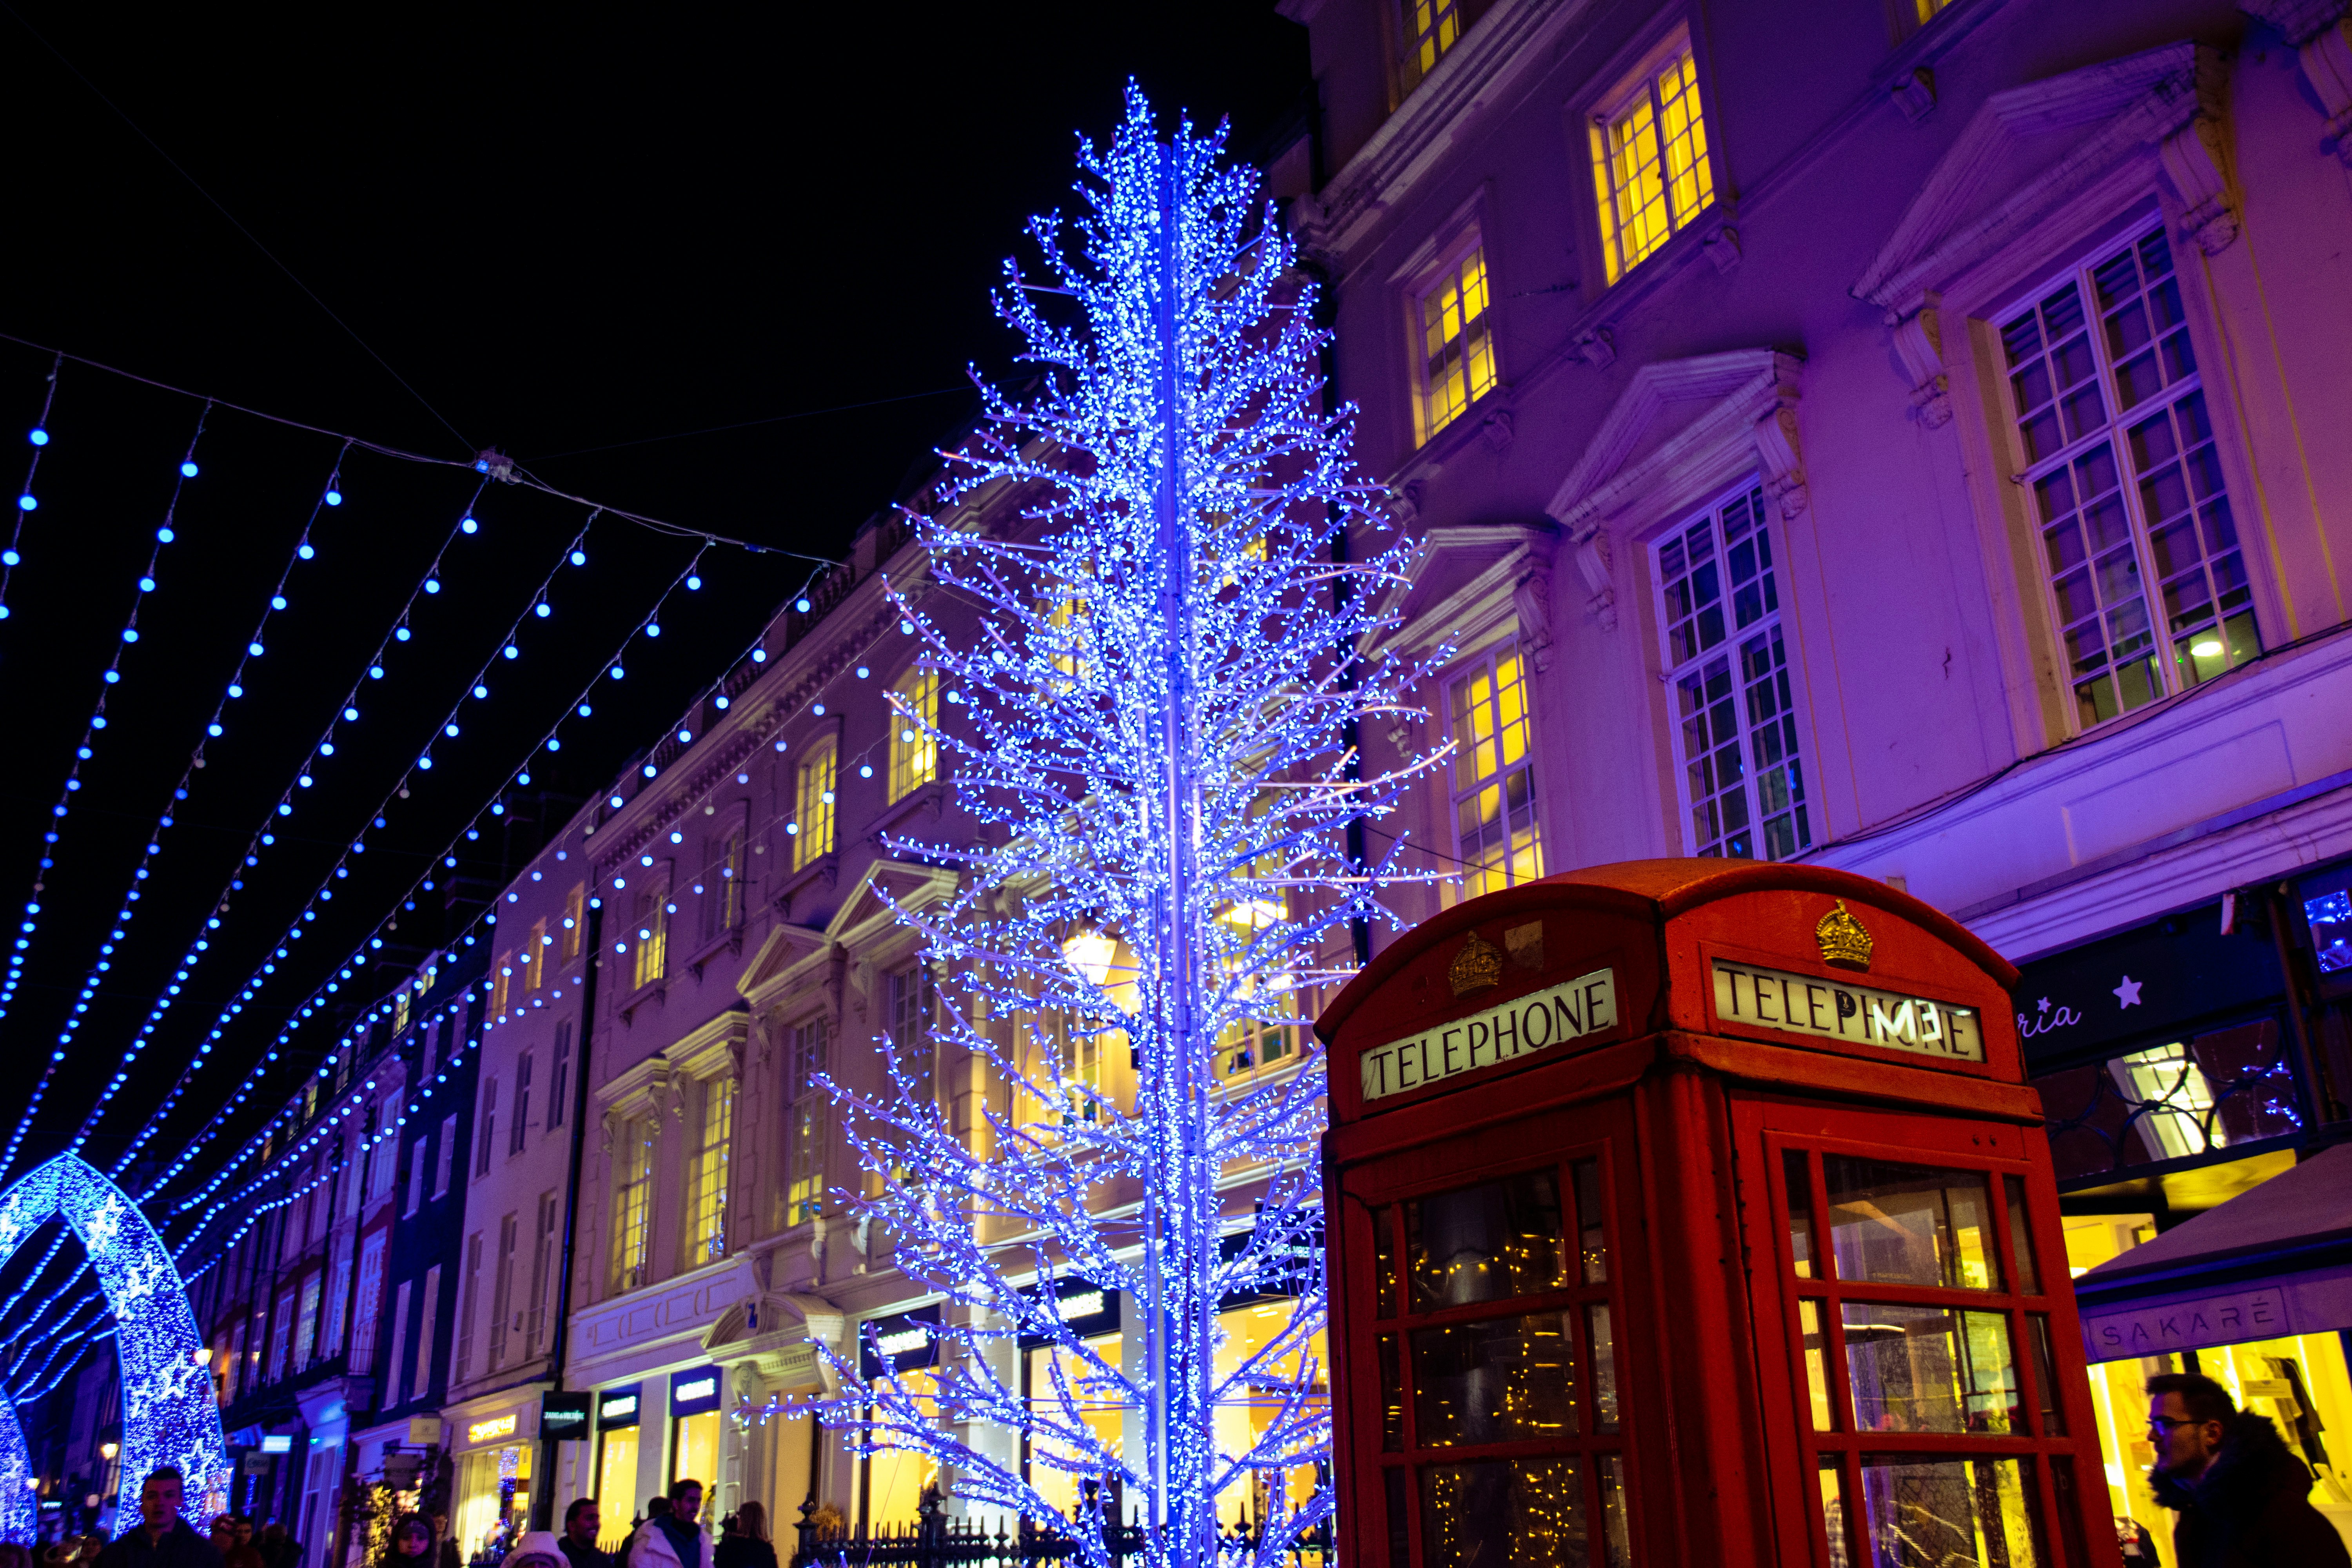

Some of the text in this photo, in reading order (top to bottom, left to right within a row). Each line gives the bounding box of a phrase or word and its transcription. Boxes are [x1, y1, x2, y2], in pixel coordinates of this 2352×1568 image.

[1370, 980, 1610, 1094] TELEPHONE
[1717, 967, 1970, 1056] TELEPHONE
[2102, 1297, 2274, 1346] SAKARÉ
